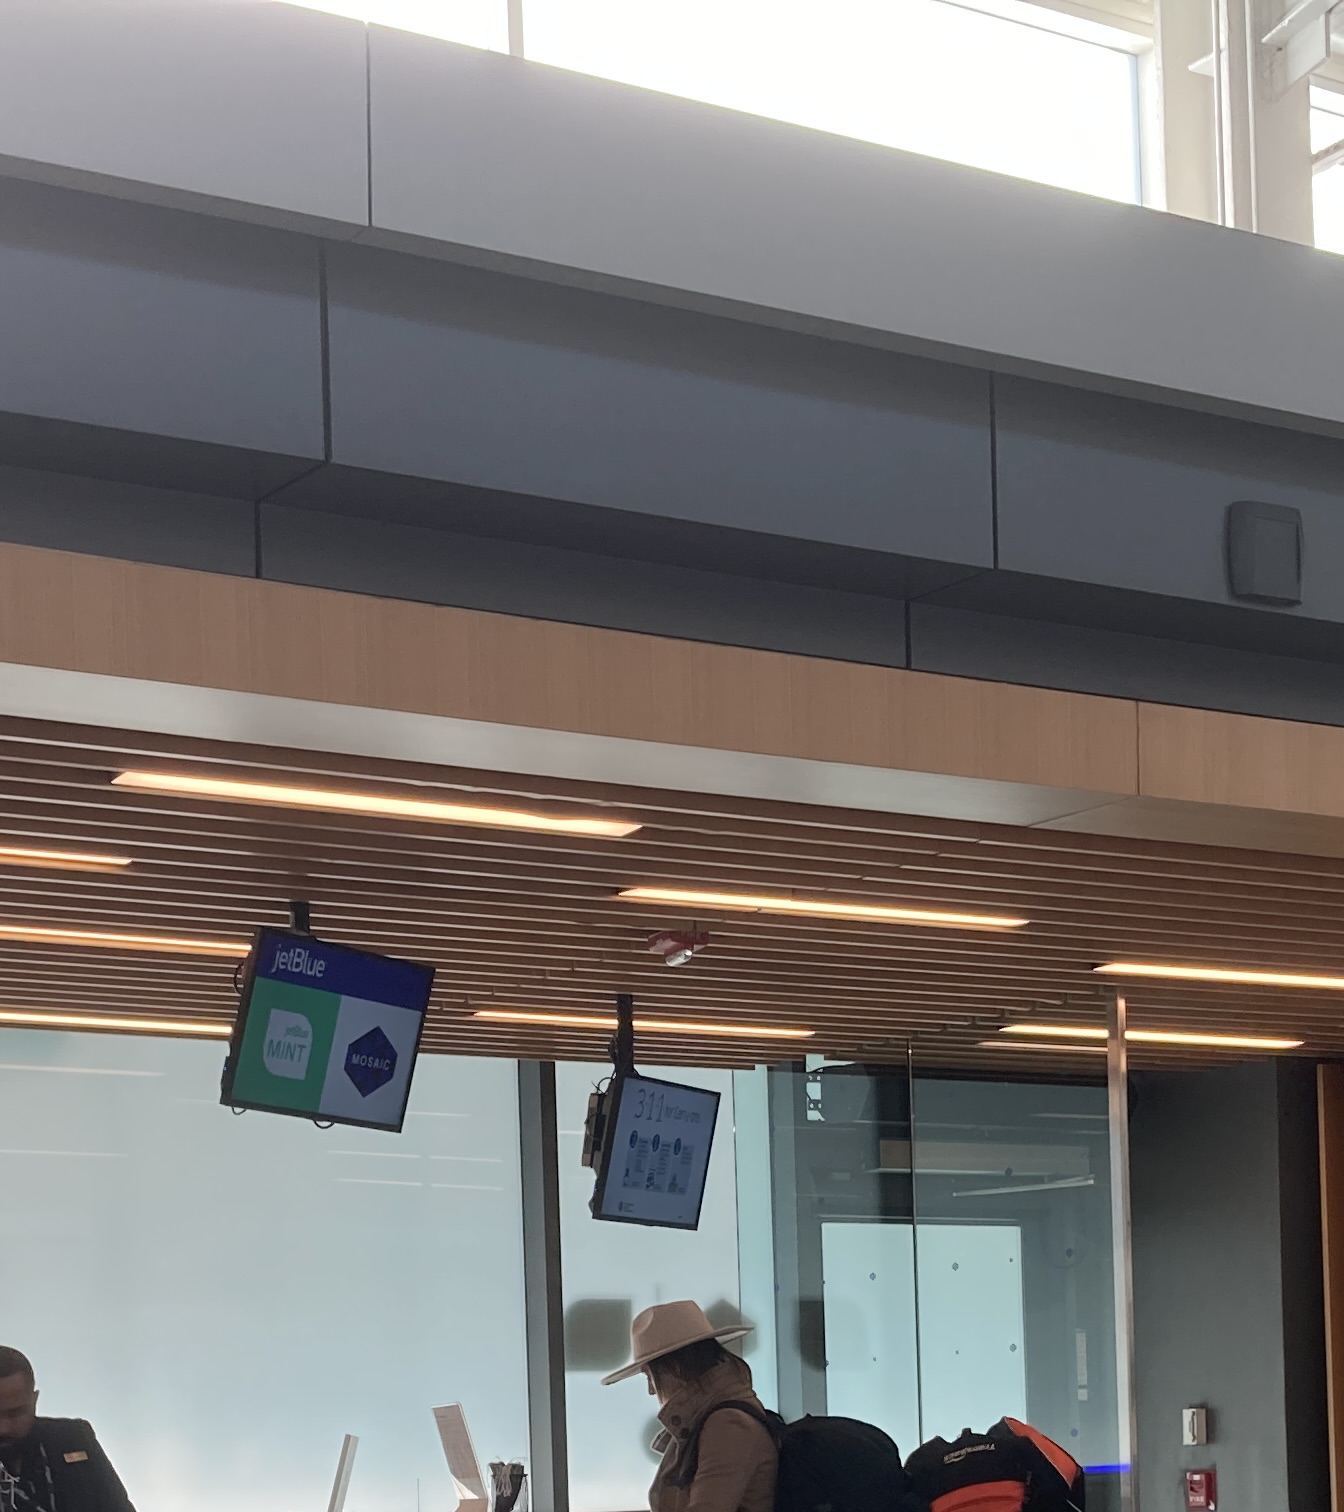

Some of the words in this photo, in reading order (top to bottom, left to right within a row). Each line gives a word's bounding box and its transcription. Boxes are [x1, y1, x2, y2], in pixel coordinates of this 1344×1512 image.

[271, 944, 326, 977] jetBlue
[267, 1039, 307, 1063] MINT
[351, 1053, 391, 1071] MOSAIC
